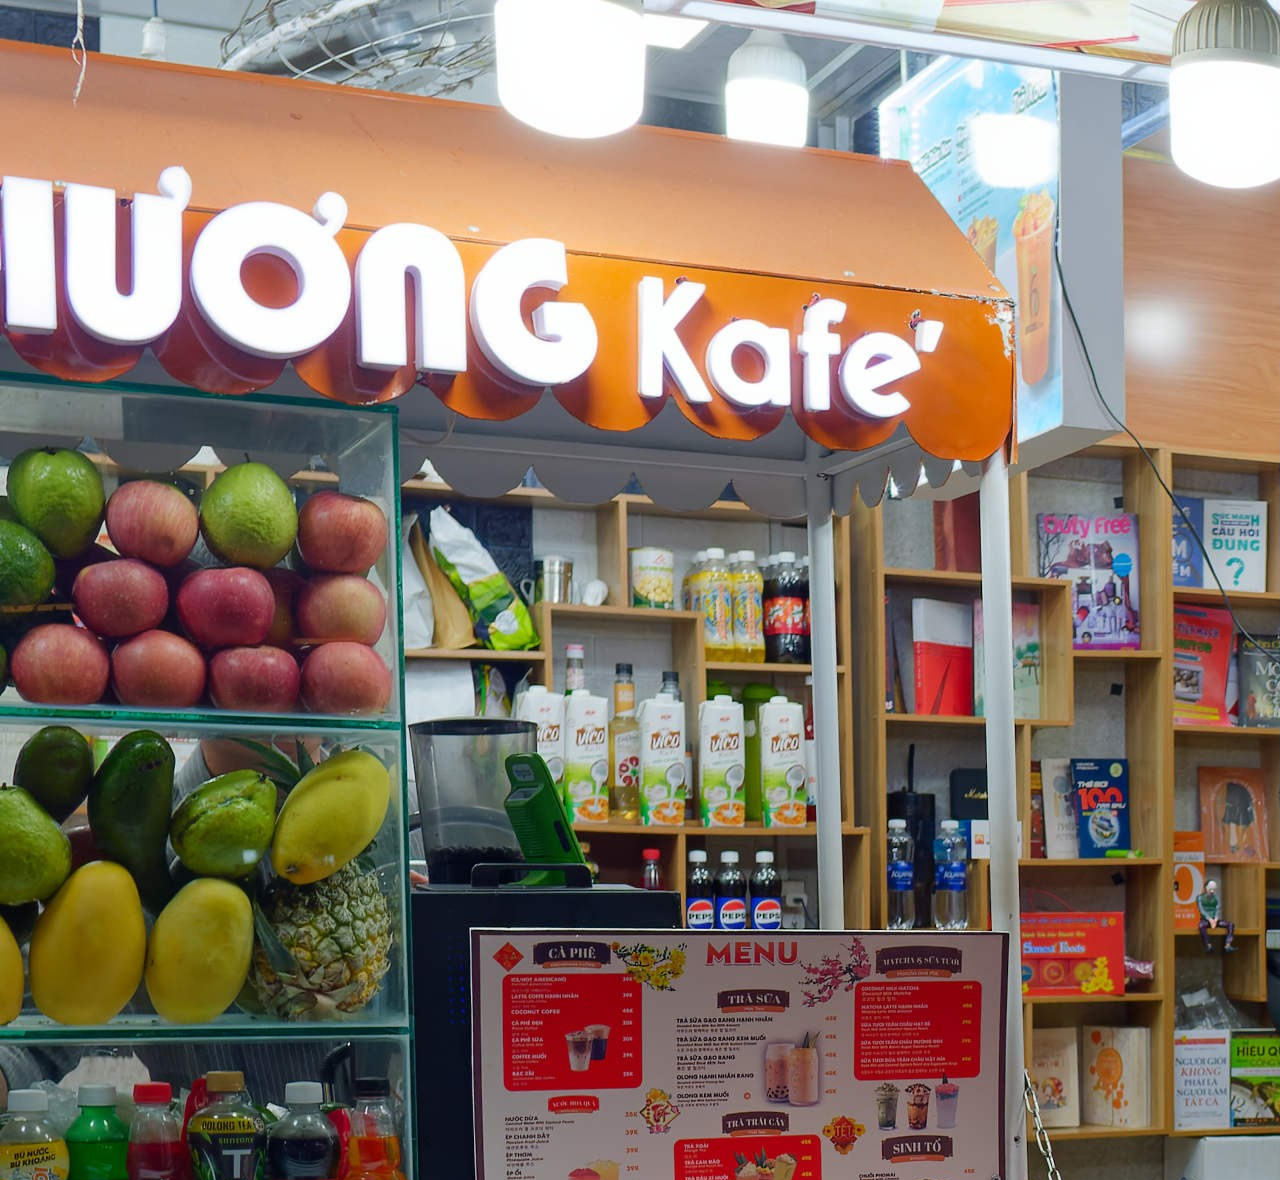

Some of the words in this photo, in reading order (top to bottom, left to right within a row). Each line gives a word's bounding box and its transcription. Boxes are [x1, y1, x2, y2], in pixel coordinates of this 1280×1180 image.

[651, 731, 680, 748] VICO
[711, 734, 739, 752] VICO
[772, 734, 799, 751] VICO
[1078, 786, 1123, 810] 100
[548, 944, 566, 960] CÀ
[570, 945, 597, 960] PHÊ
[706, 940, 798, 967] MENU
[727, 992, 753, 1005] TRÀ
[756, 991, 781, 1005] SỮA
[726, 1118, 746, 1128] TRÀ
[892, 1141, 921, 1154] SINH
[923, 1137, 942, 1152] TỐ
